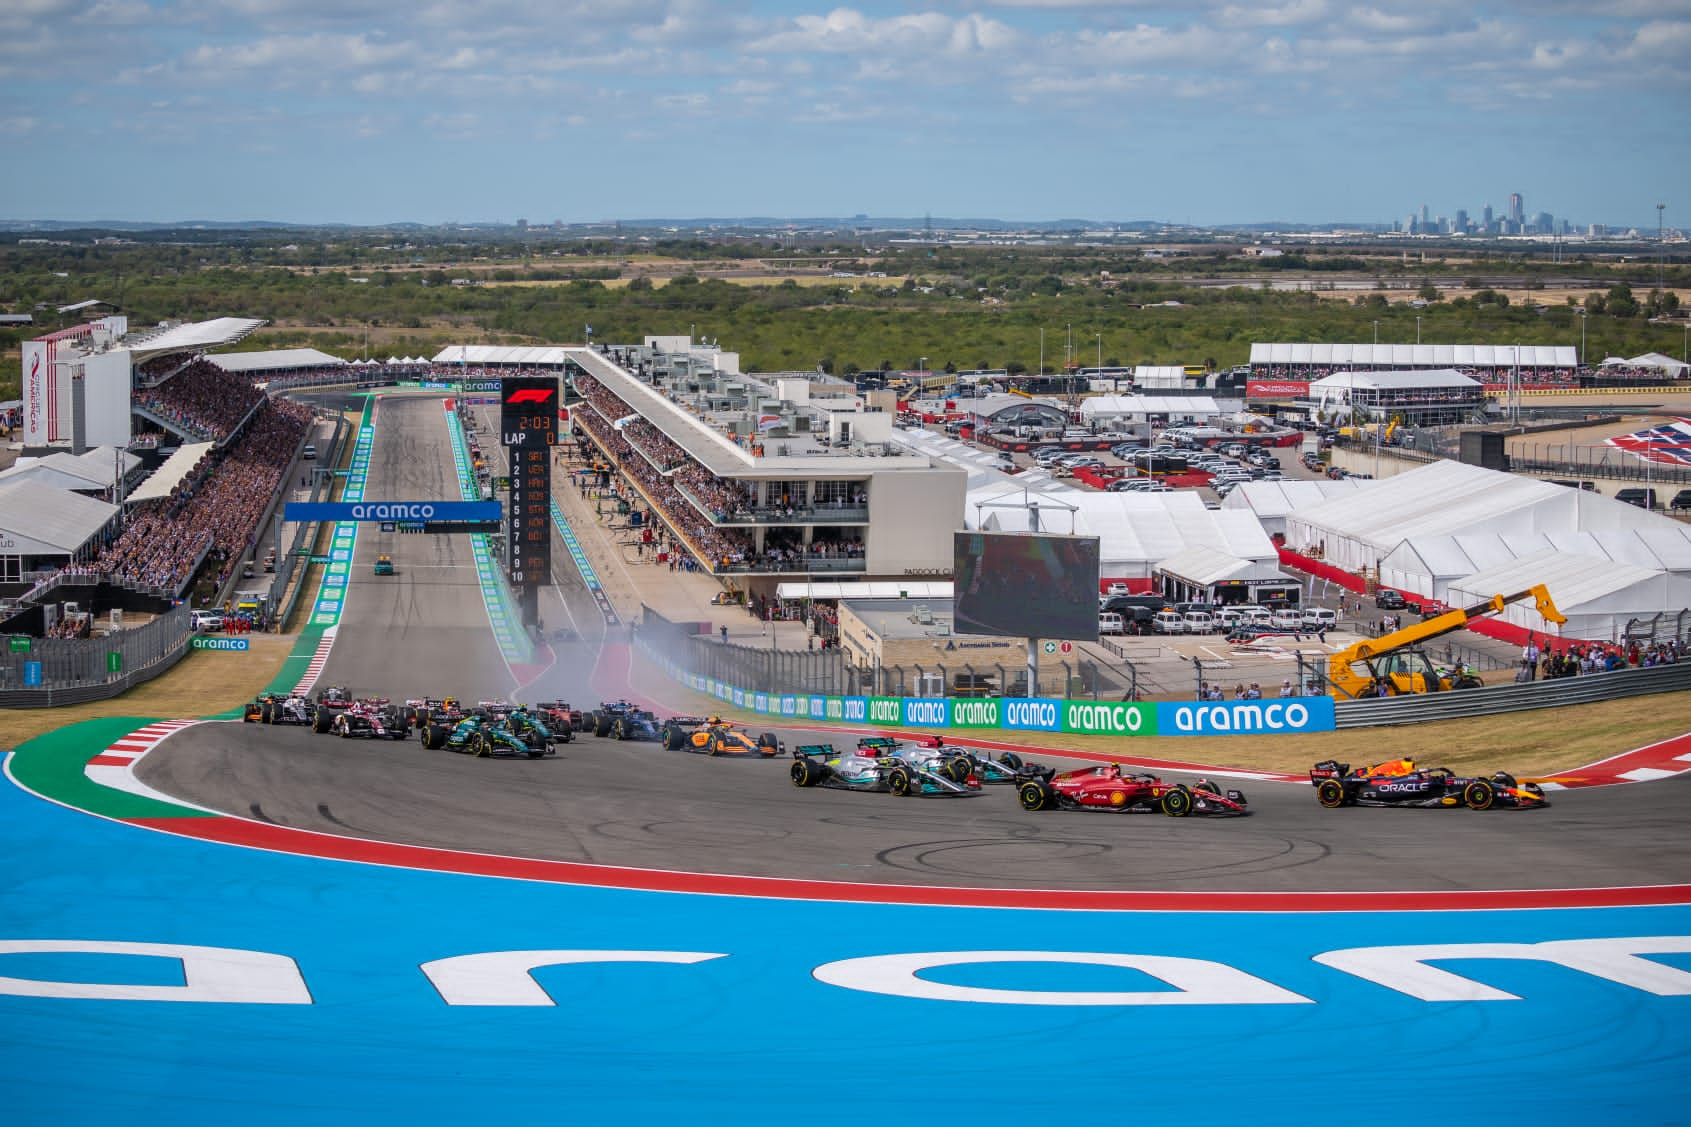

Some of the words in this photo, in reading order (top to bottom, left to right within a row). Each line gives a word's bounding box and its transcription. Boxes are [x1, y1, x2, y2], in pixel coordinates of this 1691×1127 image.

[465, 382, 502, 390] aramc
[520, 416, 551, 430] 2:03
[505, 433, 526, 444] LAP
[514, 452, 520, 462] 1
[513, 465, 520, 475] 2
[513, 479, 520, 489] 3
[513, 492, 520, 502] 4
[352, 505, 434, 518] aramco
[513, 505, 520, 515] 5
[513, 519, 520, 528] 6
[513, 532, 520, 541] 7
[514, 545, 520, 555] 8
[514, 558, 520, 568] 9
[511, 571, 523, 581] 10
[904, 568, 940, 576] PADDOCK
[193, 639, 246, 649] aramco
[870, 701, 899, 721] aramco
[908, 702, 944, 723] aramco
[955, 703, 997, 724] aramco
[1008, 703, 1055, 726] aramco
[1069, 705, 1142, 731] aramco
[1175, 703, 1309, 731] aramco
[1379, 783, 1429, 792] ORACLE
